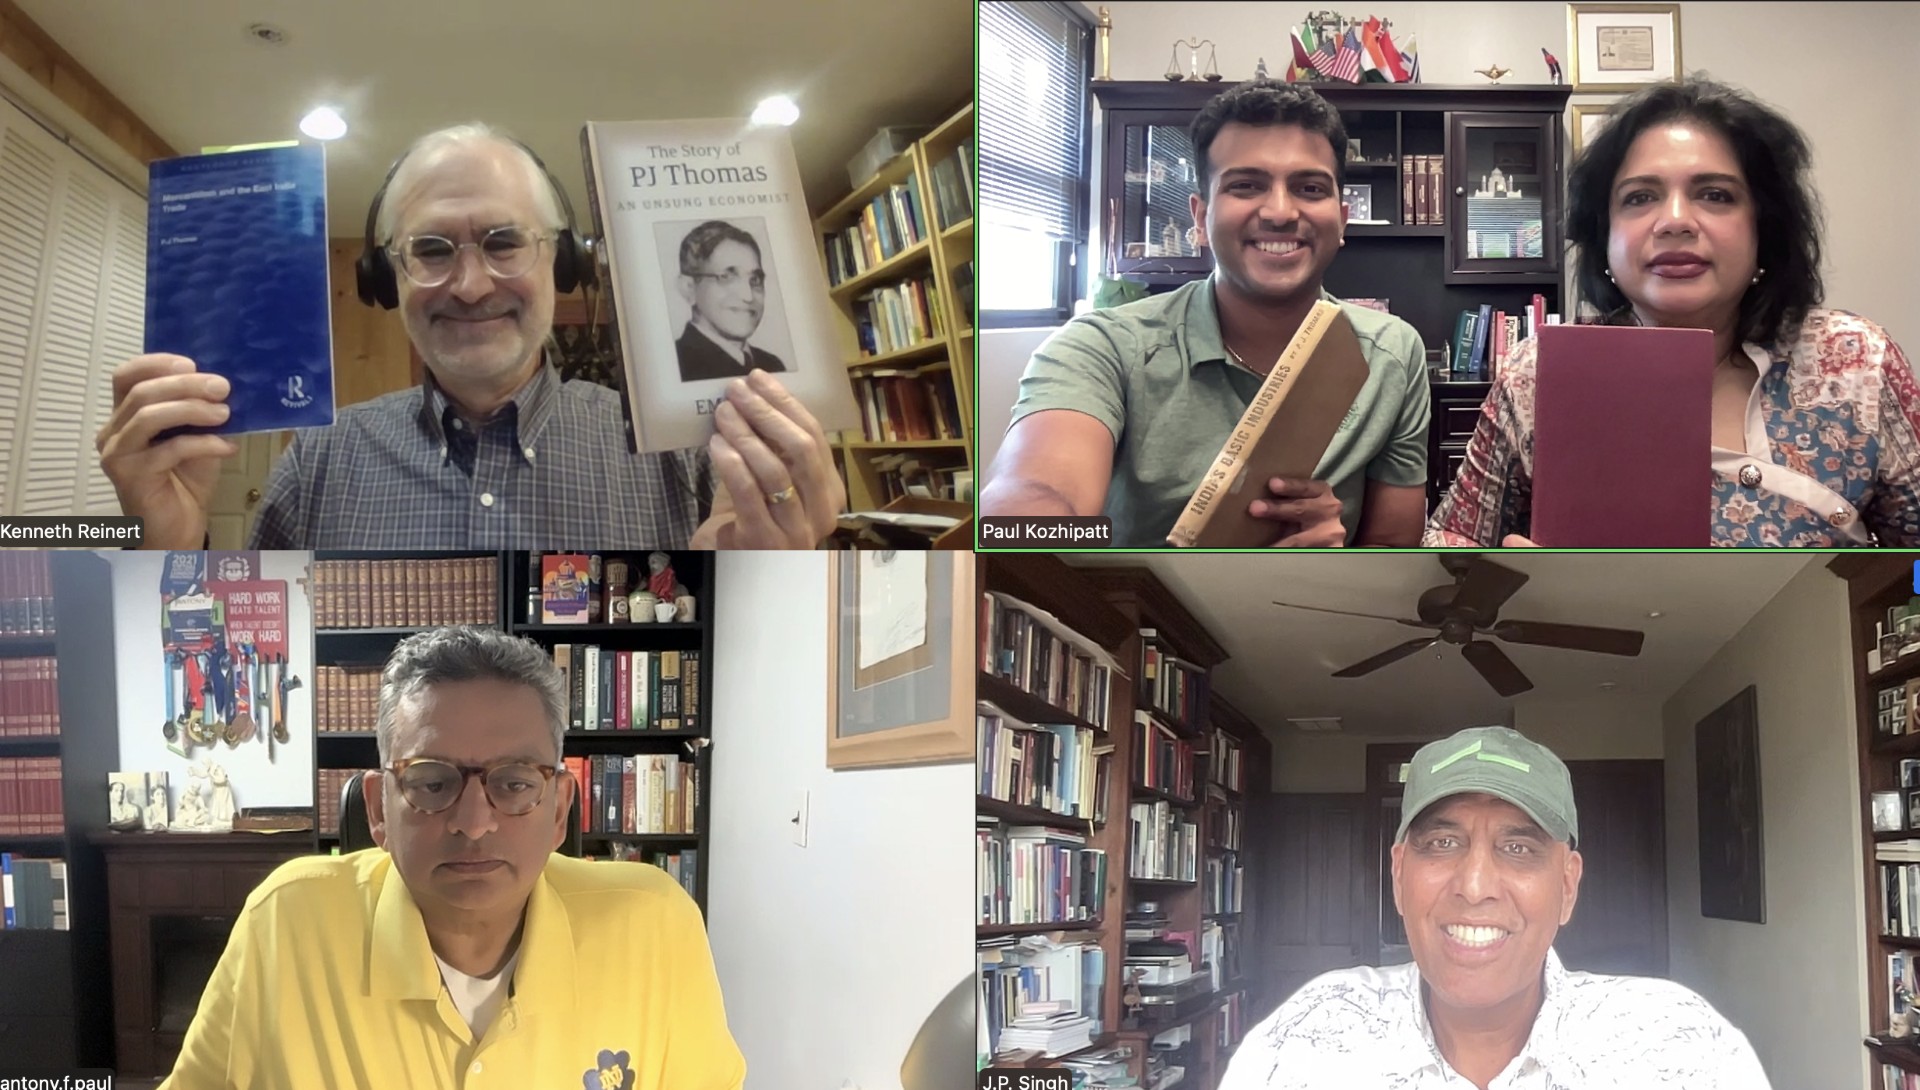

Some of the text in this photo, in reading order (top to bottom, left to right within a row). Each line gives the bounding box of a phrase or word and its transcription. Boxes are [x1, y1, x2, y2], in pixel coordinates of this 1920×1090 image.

[646, 141, 742, 160] The Story of
[629, 163, 768, 188] PJ Thomas
[219, 187, 236, 196] and
[237, 185, 251, 195] the
[616, 192, 792, 212] AN UNSUNG ECONOMIST
[288, 375, 305, 399] R
[1220, 430, 1250, 468] BASIC
[1244, 364, 1291, 428] INDUSTRIES
[228, 591, 281, 605] HARD WORK
[230, 629, 282, 643] WORK HARD
